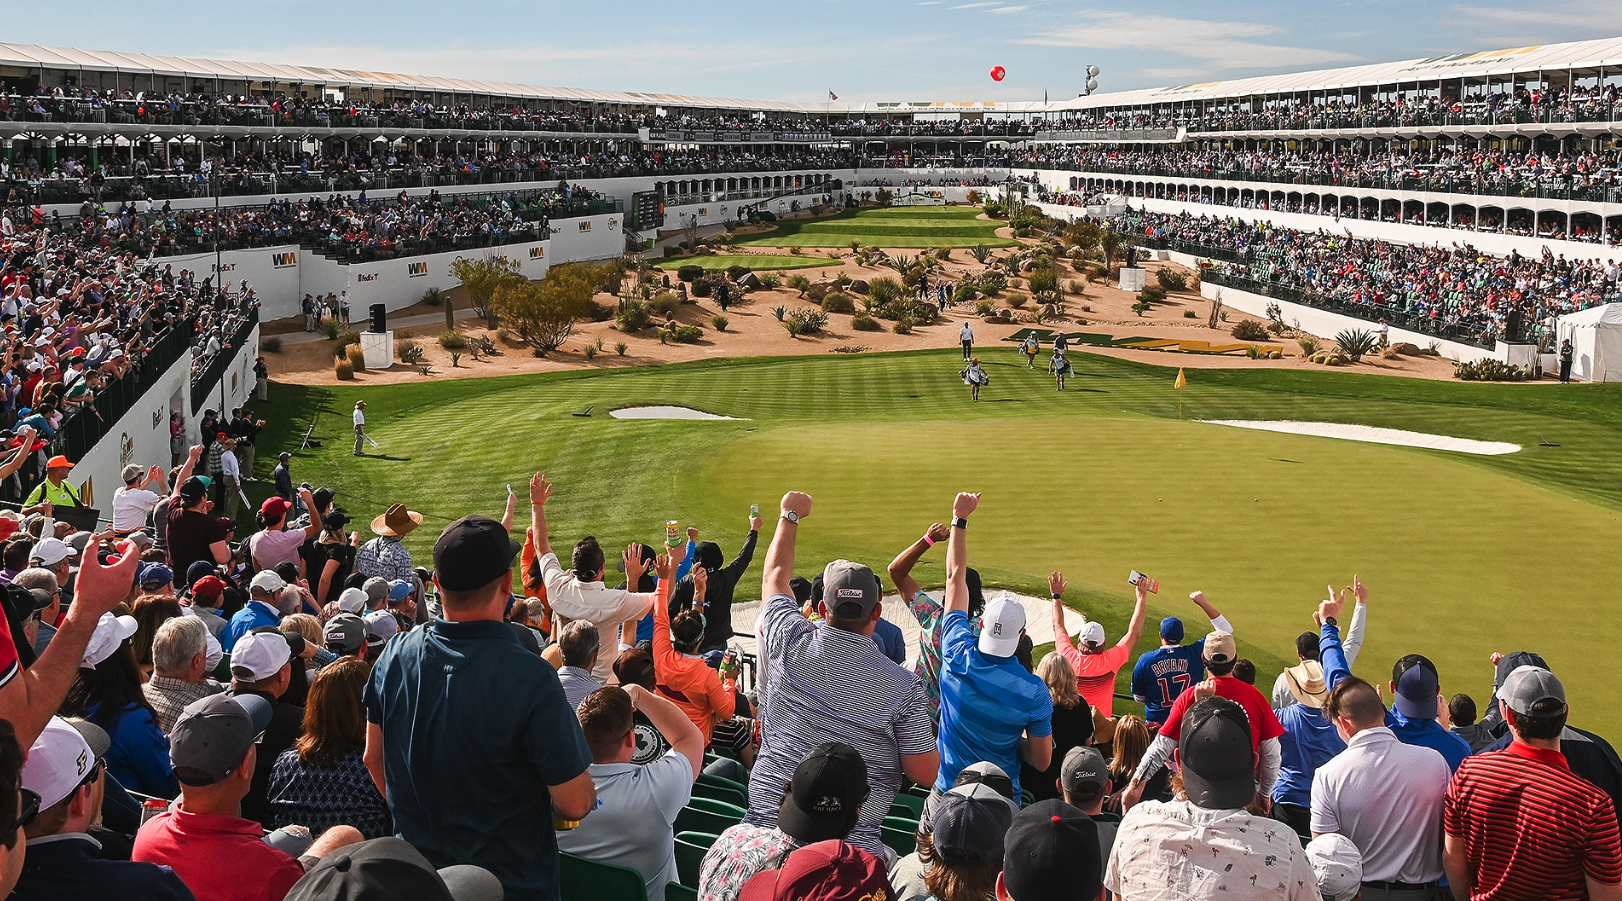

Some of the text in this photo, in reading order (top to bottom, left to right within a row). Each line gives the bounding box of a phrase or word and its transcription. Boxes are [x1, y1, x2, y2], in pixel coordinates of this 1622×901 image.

[578, 221, 592, 230] WM
[529, 247, 544, 258] WM
[272, 252, 297, 266] WM
[408, 262, 428, 274] WM
[1157, 673, 1191, 707] 17
